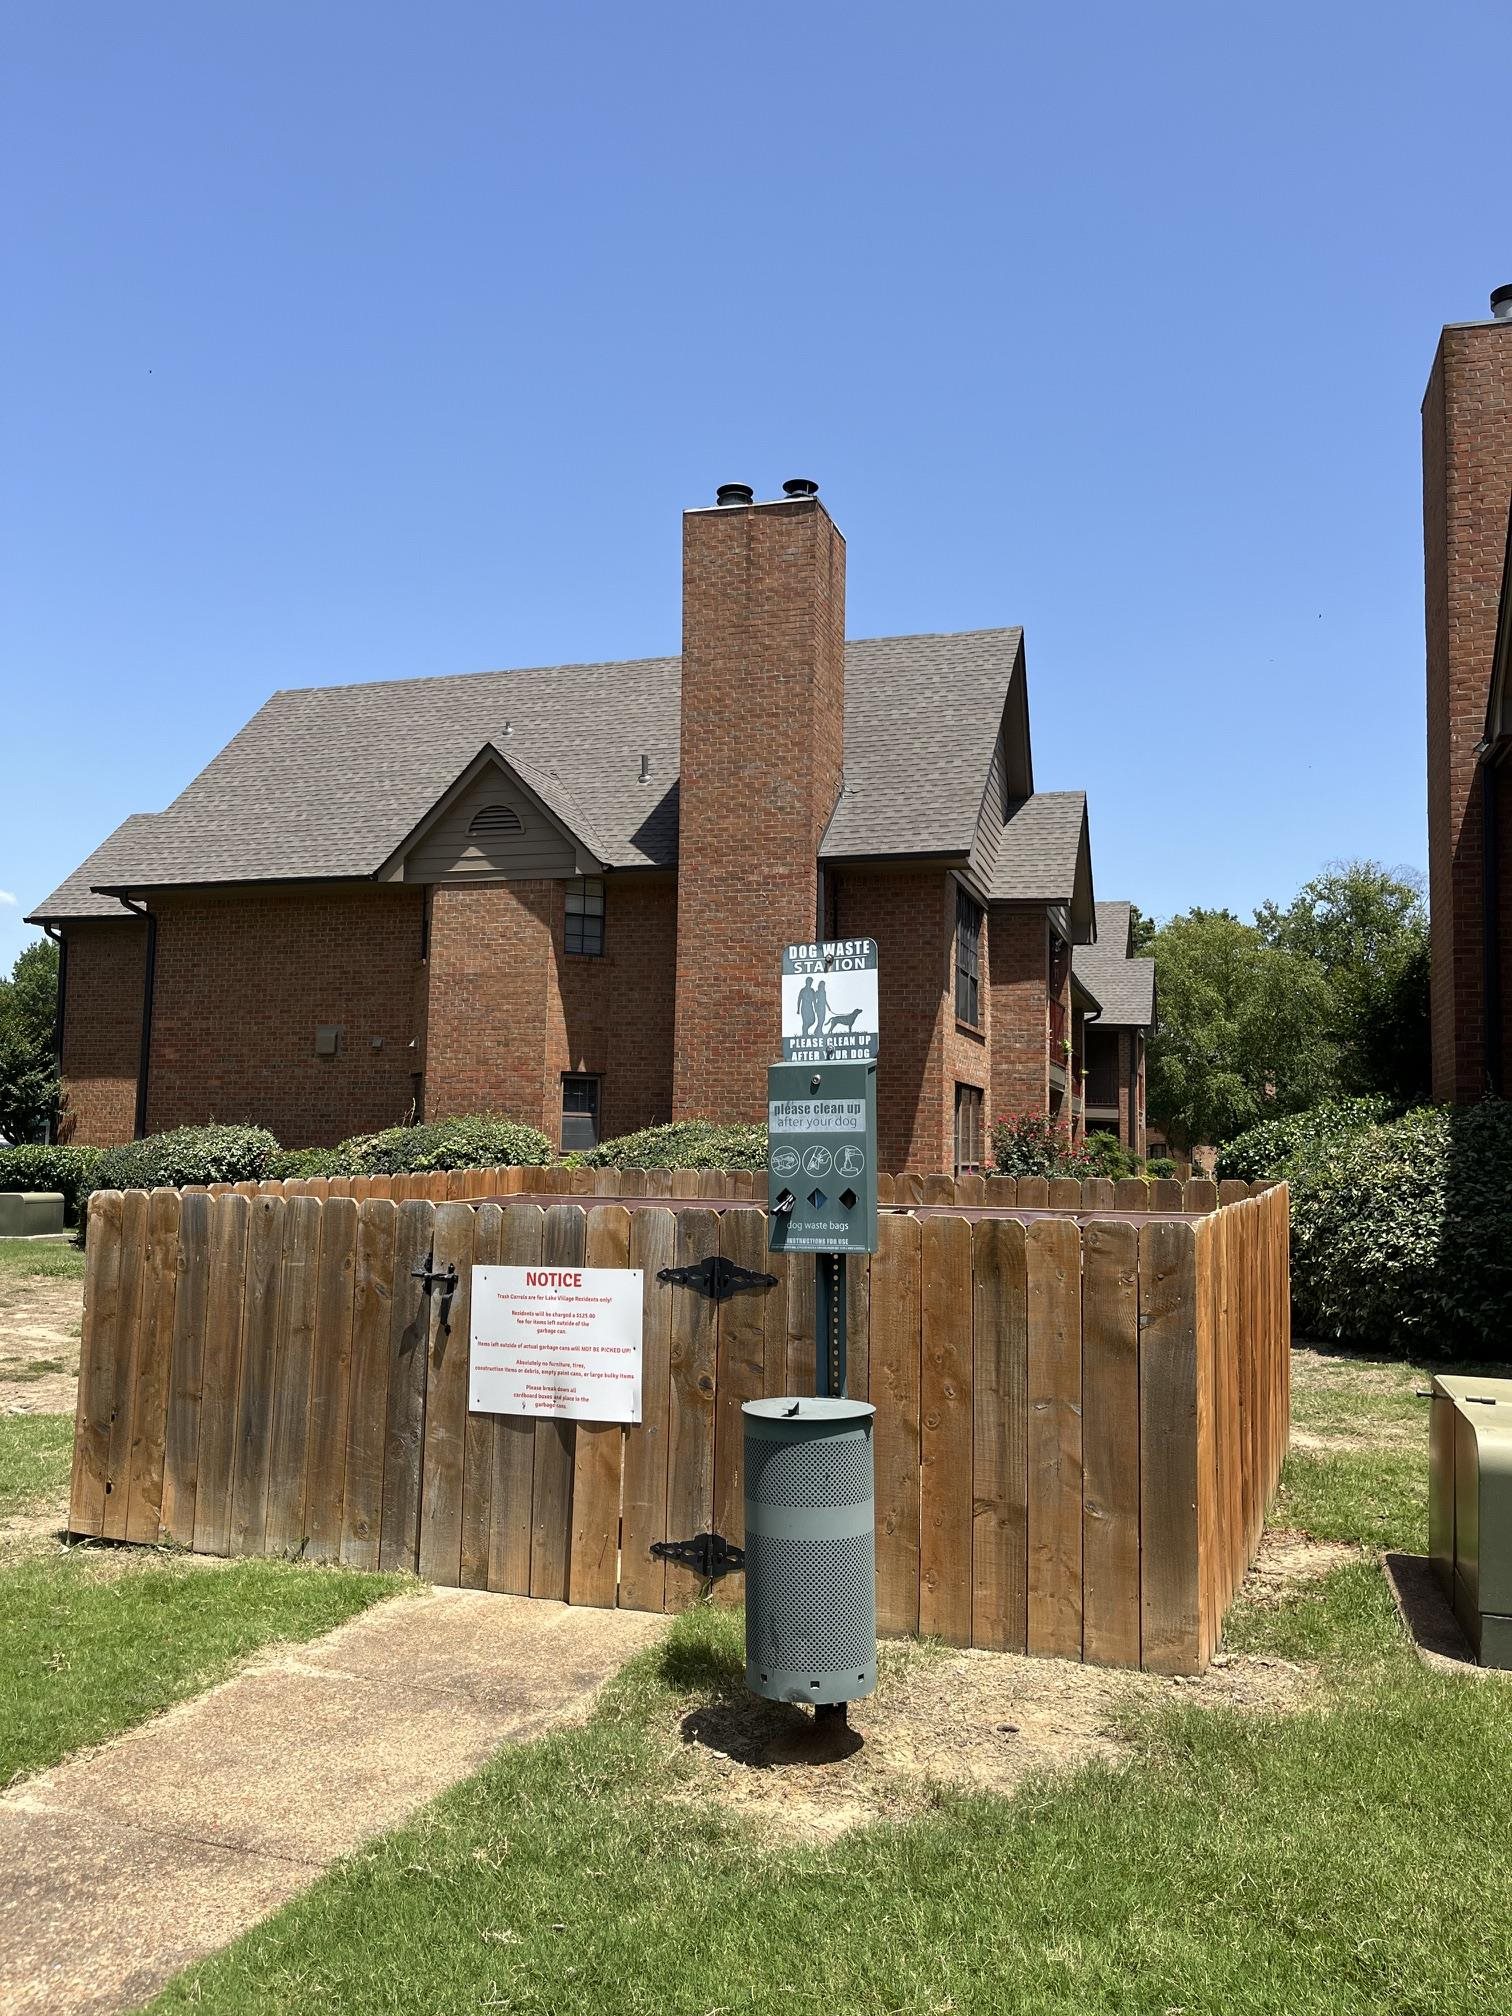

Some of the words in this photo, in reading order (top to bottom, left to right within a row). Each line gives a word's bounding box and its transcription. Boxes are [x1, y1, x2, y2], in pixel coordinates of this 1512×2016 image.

[788, 944, 818, 960] DOG
[822, 940, 870, 957] WASTE
[793, 957, 866, 974] STAION
[789, 1038, 824, 1049] PLEASE
[826, 1036, 856, 1047] CLEAN
[858, 1035, 871, 1046] UP
[791, 1050, 820, 1062] AFTER
[850, 1048, 870, 1059] DOG
[774, 1103, 811, 1117] please
[813, 1102, 844, 1115] clean
[847, 1103, 861, 1115] up
[777, 1116, 802, 1127] after
[806, 1118, 831, 1129] your
[834, 1115, 857, 1129] dog
[786, 1220, 803, 1231] dog
[804, 1221, 828, 1230] waste
[829, 1220, 849, 1232] bags
[786, 1237, 826, 1245] INSTRUCTIONS
[526, 1272, 582, 1287] NOTICE
[539, 1344, 558, 1352] garbage
